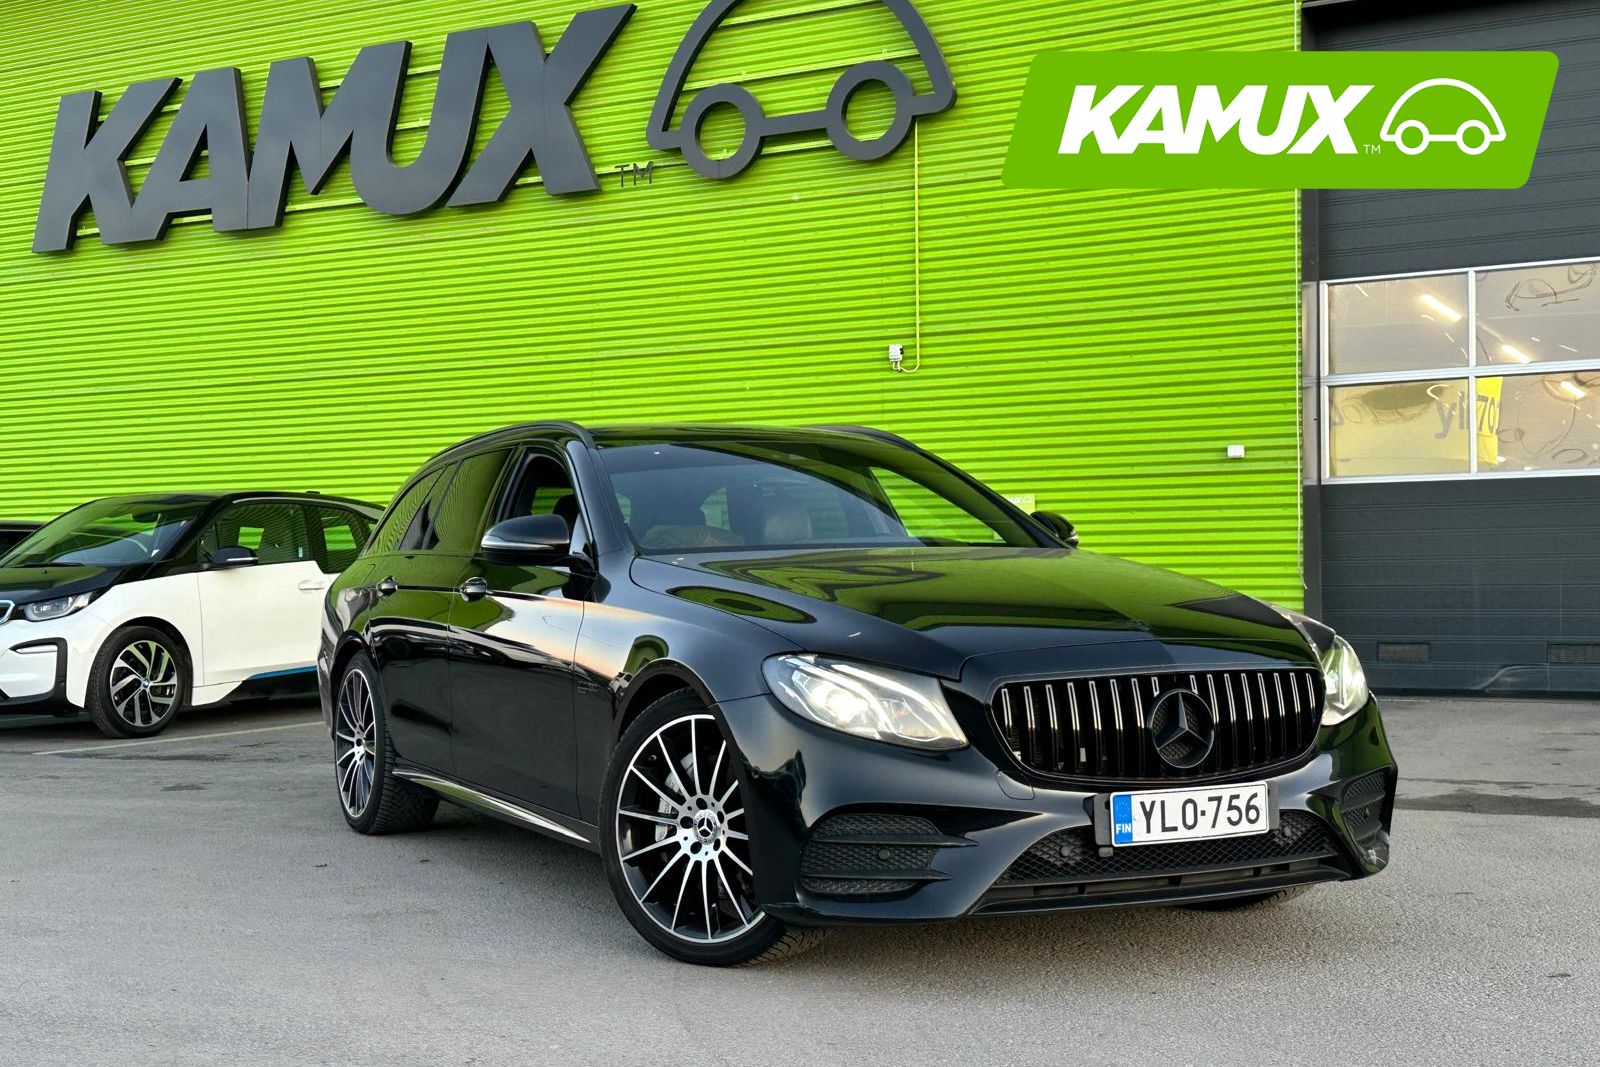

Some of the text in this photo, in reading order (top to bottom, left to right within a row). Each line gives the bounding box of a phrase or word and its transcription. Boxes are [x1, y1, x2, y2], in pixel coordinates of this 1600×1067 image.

[32, 3, 654, 253] KAMUX TM
[1115, 823, 1132, 834] FIN
